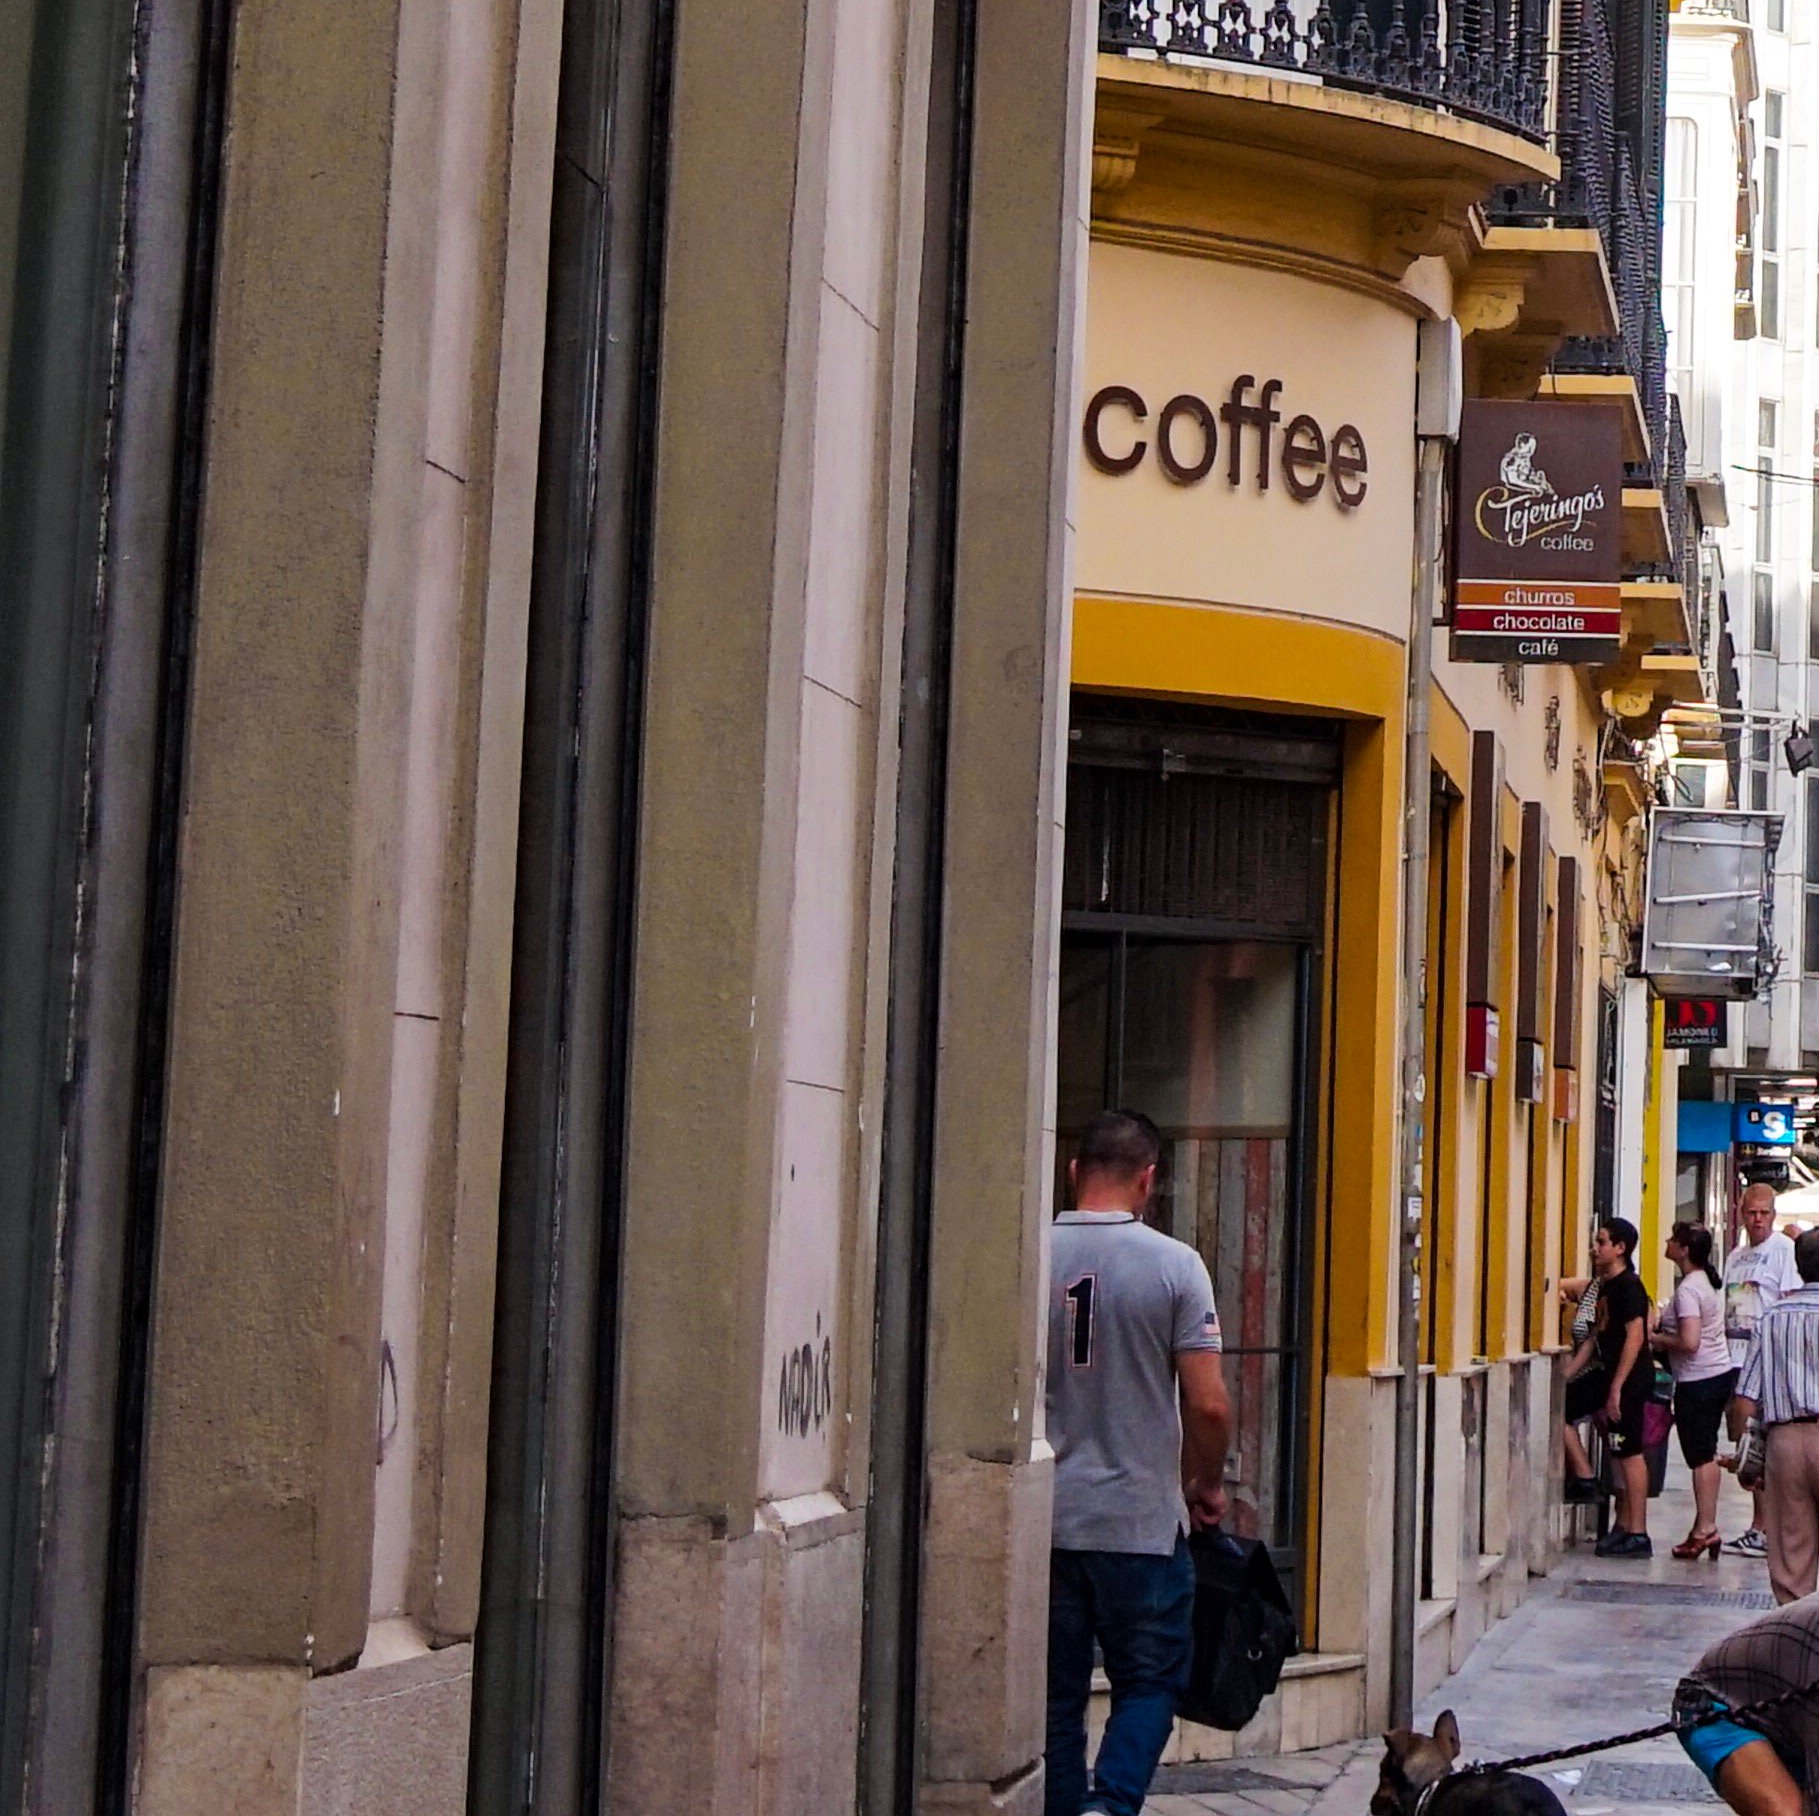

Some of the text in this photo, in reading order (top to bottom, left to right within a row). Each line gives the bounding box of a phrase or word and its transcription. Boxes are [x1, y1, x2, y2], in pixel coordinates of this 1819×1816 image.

[1083, 374, 1368, 507] coffee
[1541, 534, 1594, 552] coffee
[1504, 588, 1575, 605] churros
[1493, 613, 1585, 631] chocolate
[1518, 639, 1559, 656] café
[1065, 1273, 1097, 1368] 1
